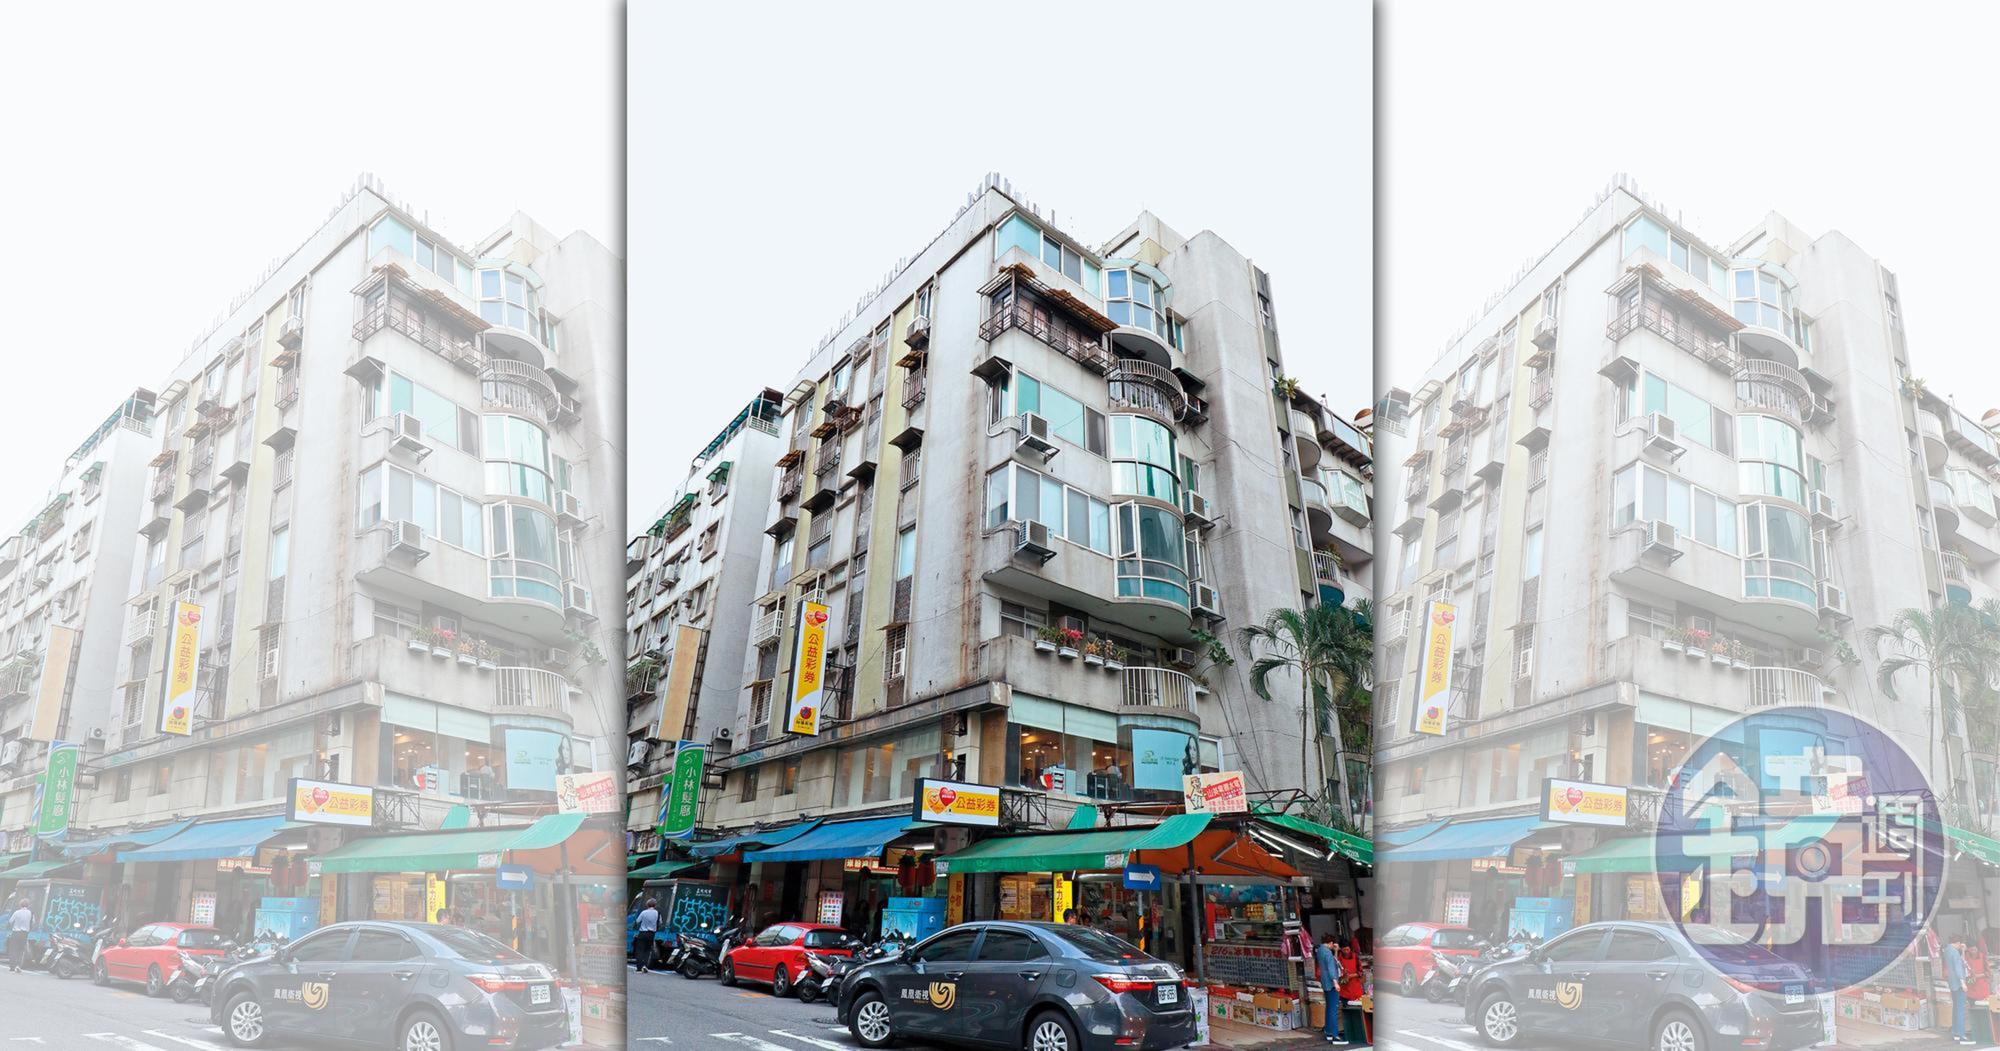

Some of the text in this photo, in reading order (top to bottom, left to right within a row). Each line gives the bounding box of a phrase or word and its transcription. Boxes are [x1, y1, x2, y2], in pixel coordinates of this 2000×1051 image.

[177, 633, 192, 684] 公益彩券
[804, 633, 819, 684] 公益彩券
[1431, 633, 1446, 684] 公益彩券
[329, 796, 368, 812] 公益彩券
[956, 796, 995, 812] 公益彩券
[1583, 796, 1622, 812] 公益彩券
